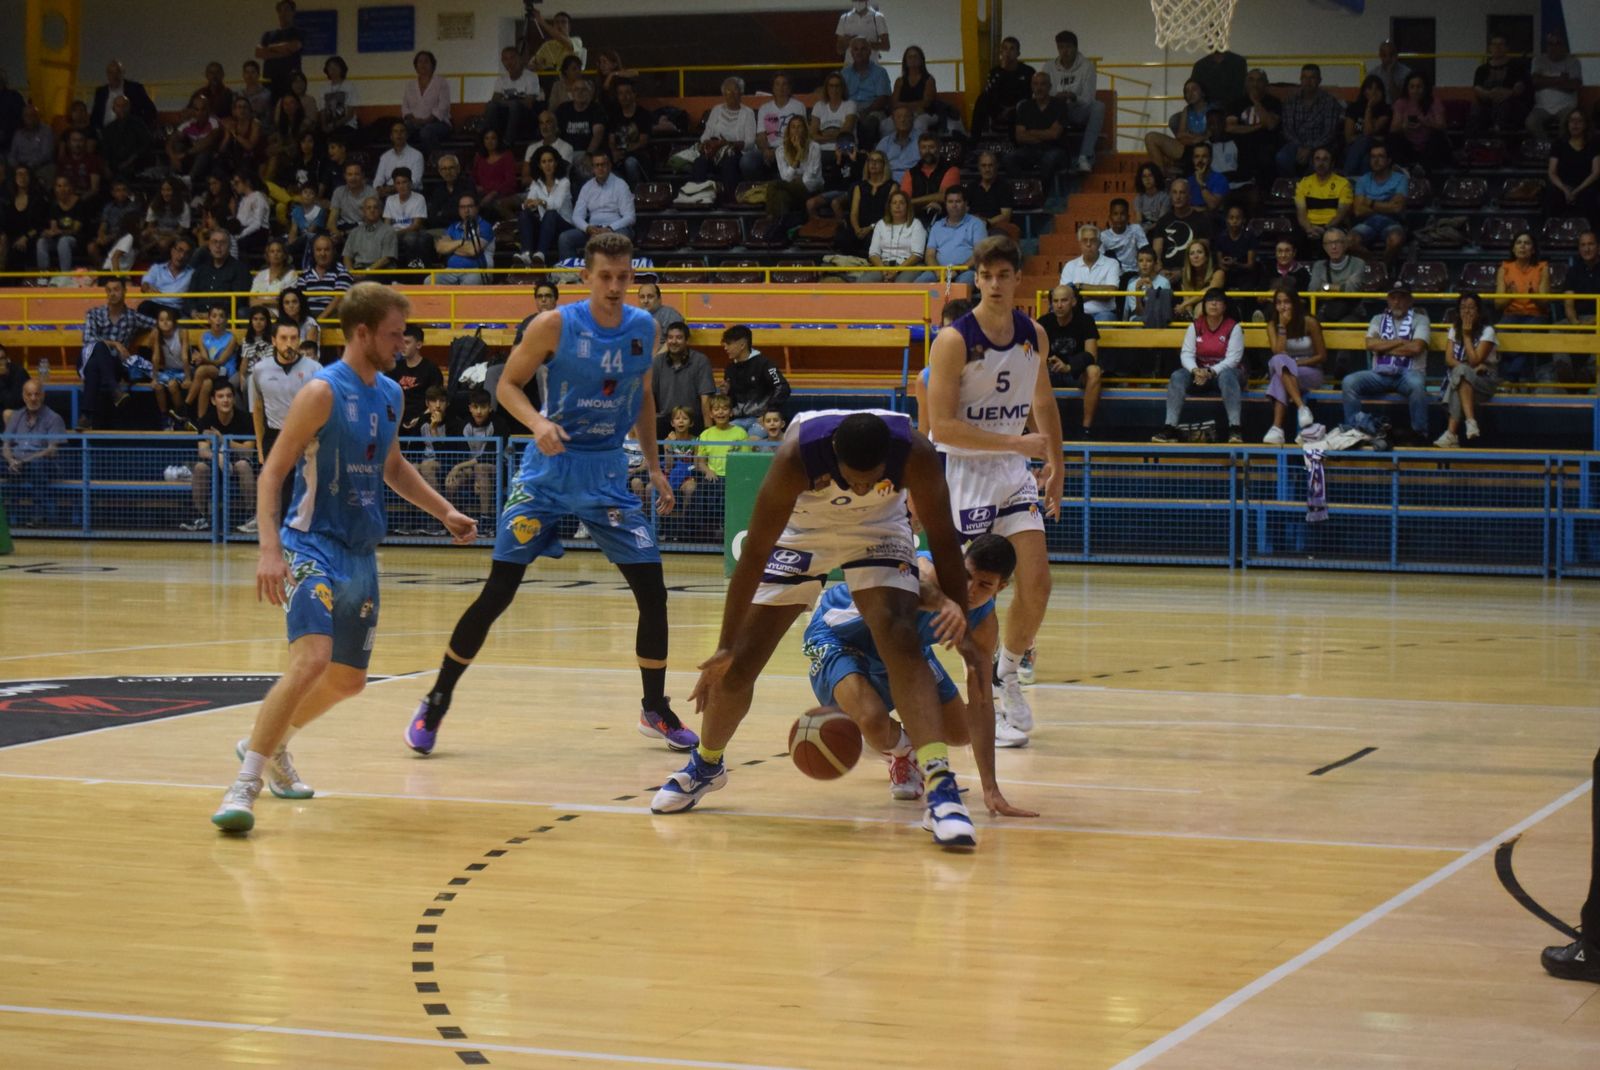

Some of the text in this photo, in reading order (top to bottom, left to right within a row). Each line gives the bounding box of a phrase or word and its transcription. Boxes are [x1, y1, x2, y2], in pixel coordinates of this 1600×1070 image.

[600, 349, 623, 373] 44
[996, 371, 1010, 393] 5
[967, 404, 1030, 420] UEMC
[369, 412, 379, 437] 9
